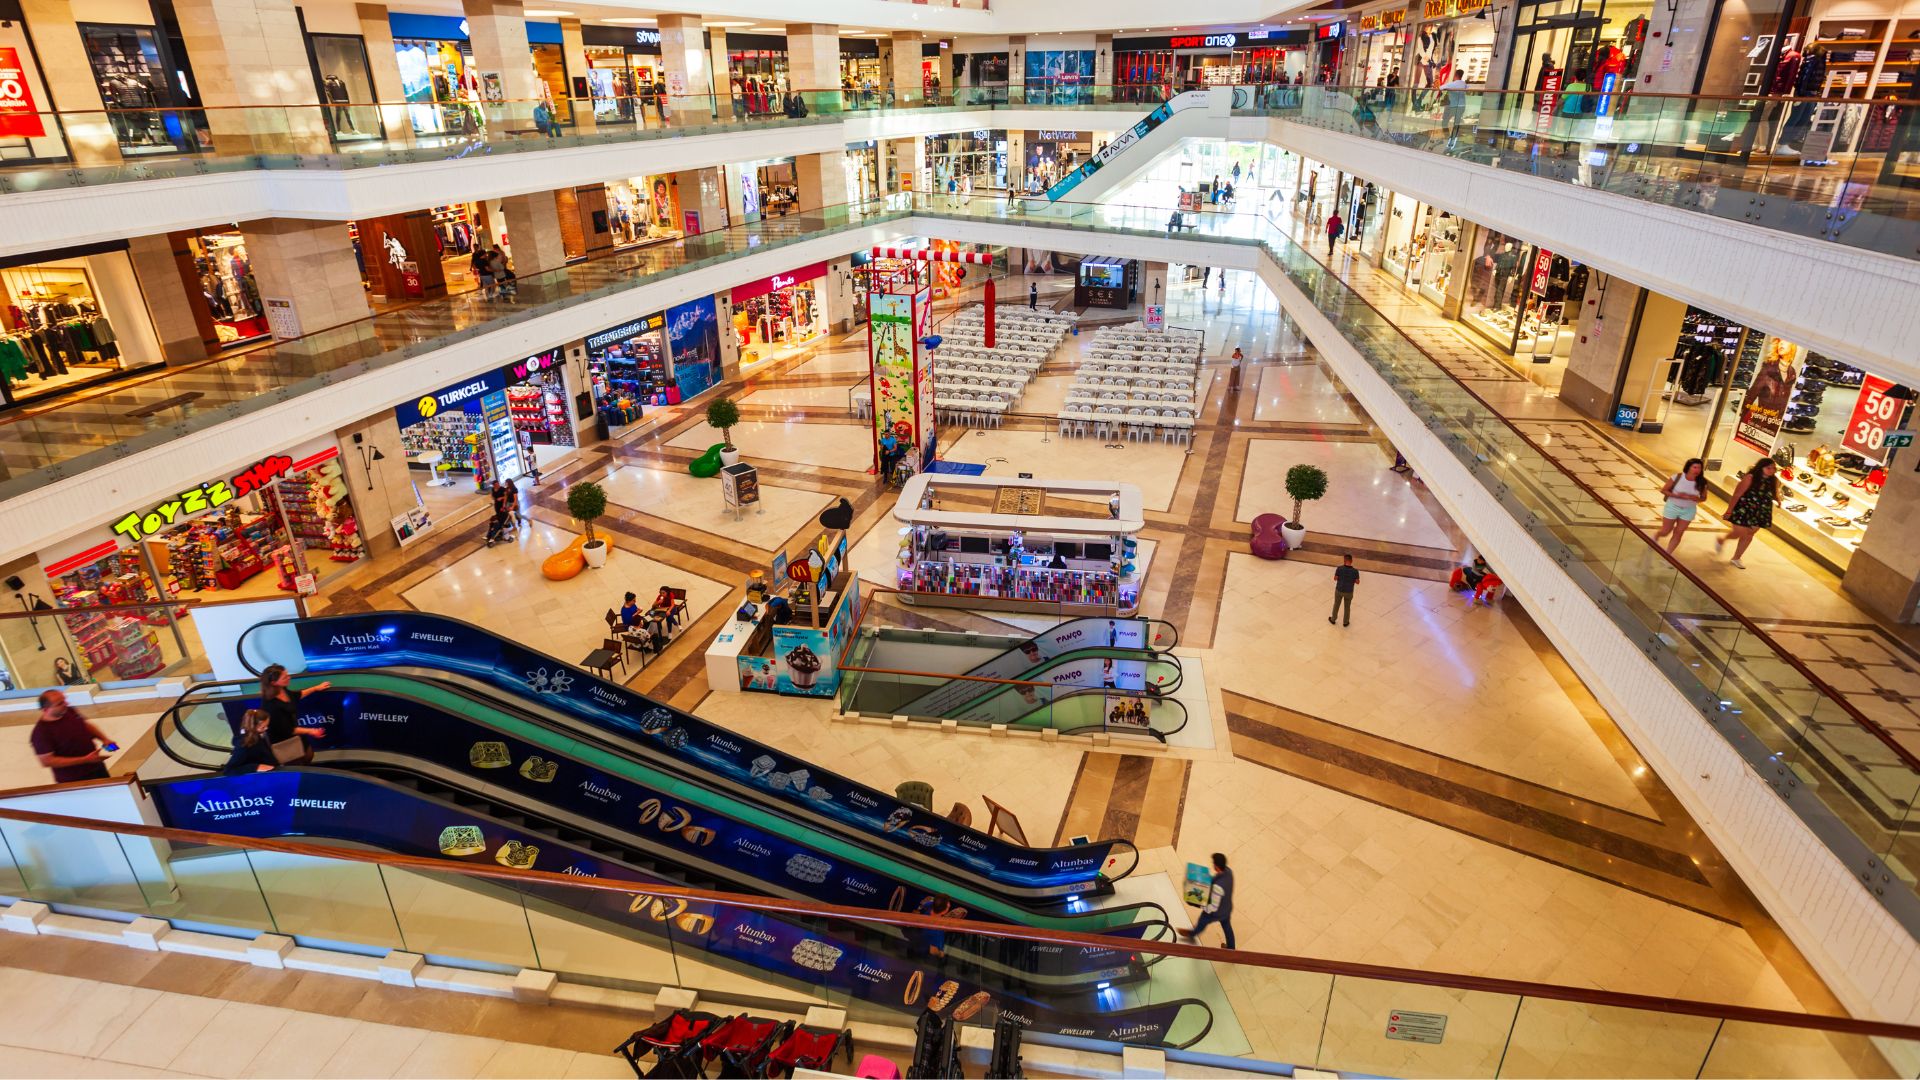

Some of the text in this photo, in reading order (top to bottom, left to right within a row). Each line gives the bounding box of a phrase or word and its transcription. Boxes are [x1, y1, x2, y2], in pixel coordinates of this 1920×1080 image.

[1534, 273, 1546, 290] 30
[438, 380, 489, 407] TURKCELL
[1864, 390, 1896, 420] 50
[1618, 409, 1638, 420] 300
[1853, 421, 1884, 451] 30
[232, 455, 293, 498] SHOP
[410, 631, 454, 643] JEWELLERY
[358, 711, 409, 724] JEWELLERY
[289, 798, 347, 811] JEWELLERY
[213, 809, 260, 821] Zemin Kat
[1059, 1028, 1095, 1036] JEWELLERY
